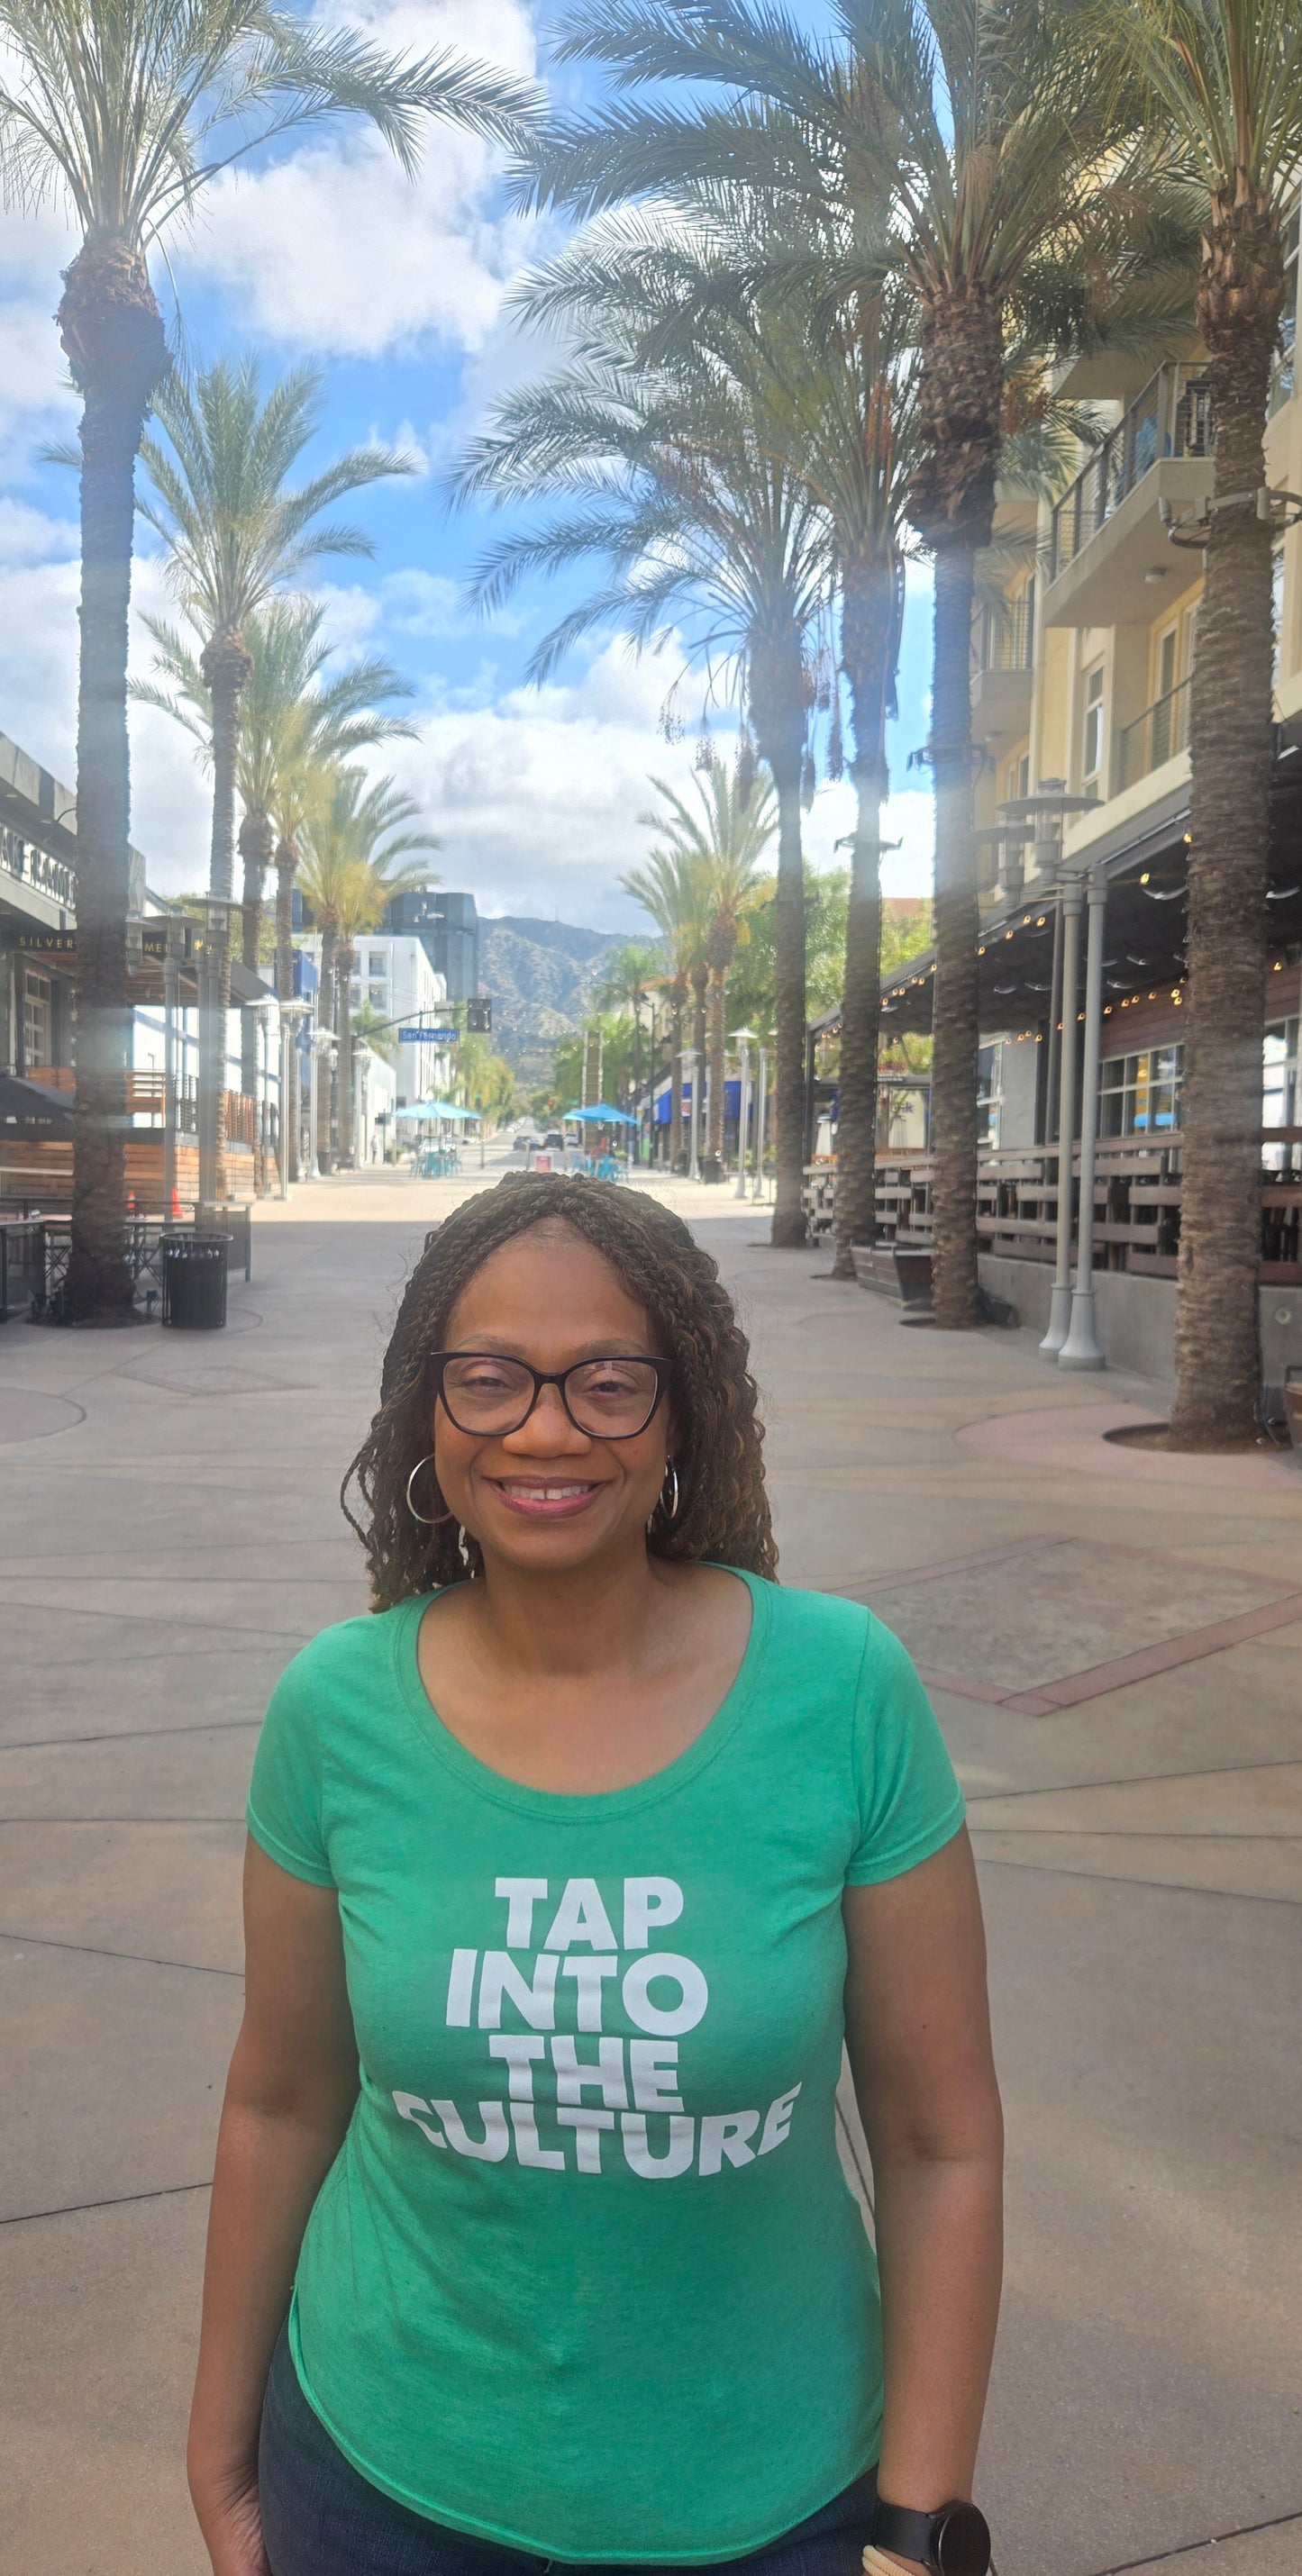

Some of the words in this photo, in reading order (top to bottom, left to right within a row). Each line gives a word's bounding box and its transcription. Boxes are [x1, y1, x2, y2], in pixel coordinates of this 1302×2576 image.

[402, 1030, 417, 1040] San
[419, 1030, 457, 1041] Fernando
[495, 1876, 684, 1951] TAP
[445, 1948, 708, 2036] INTO
[488, 2035, 684, 2112] THE
[392, 2082, 802, 2179] CULTURE
